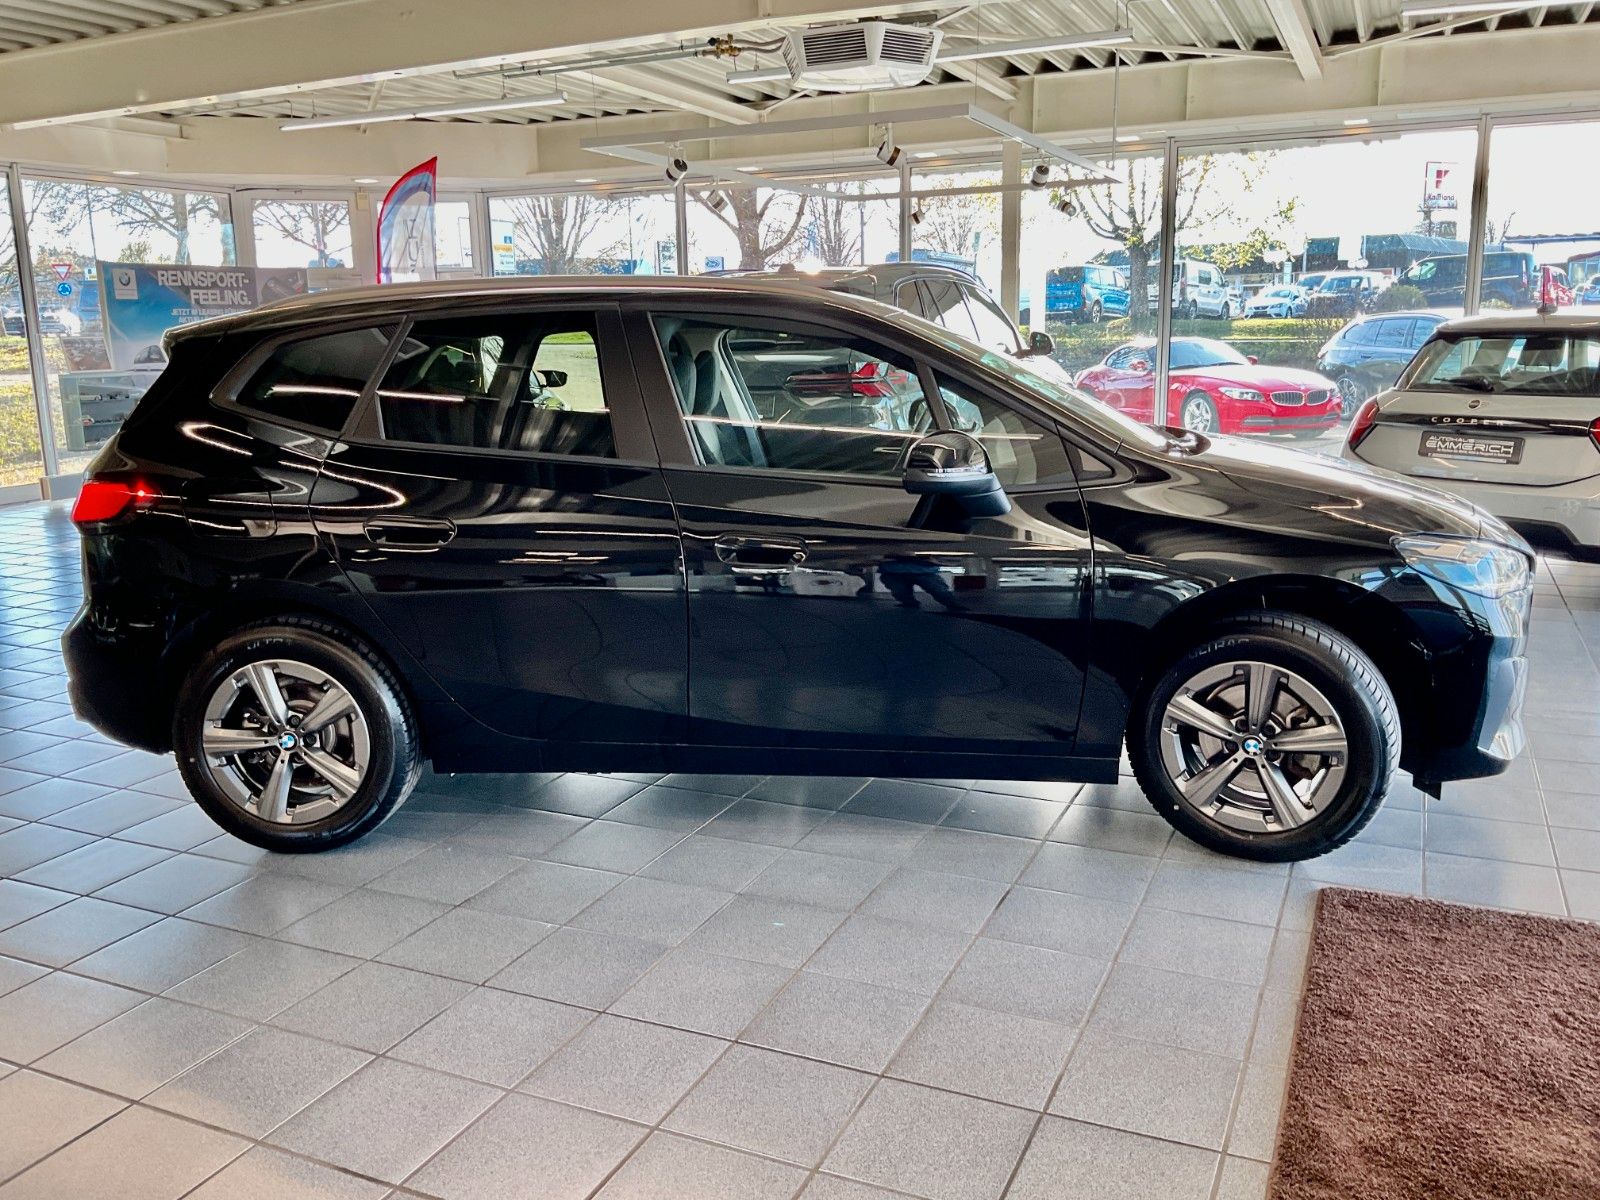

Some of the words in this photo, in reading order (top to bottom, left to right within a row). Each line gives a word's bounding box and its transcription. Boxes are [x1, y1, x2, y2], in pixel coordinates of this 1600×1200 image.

[157, 270, 249, 288] RENNSPORT-
[190, 289, 252, 306] FEELING.
[1431, 416, 1504, 426] COOPER
[1428, 435, 1475, 443] AUTOHAUS
[1425, 440, 1514, 454] EMMERICH
